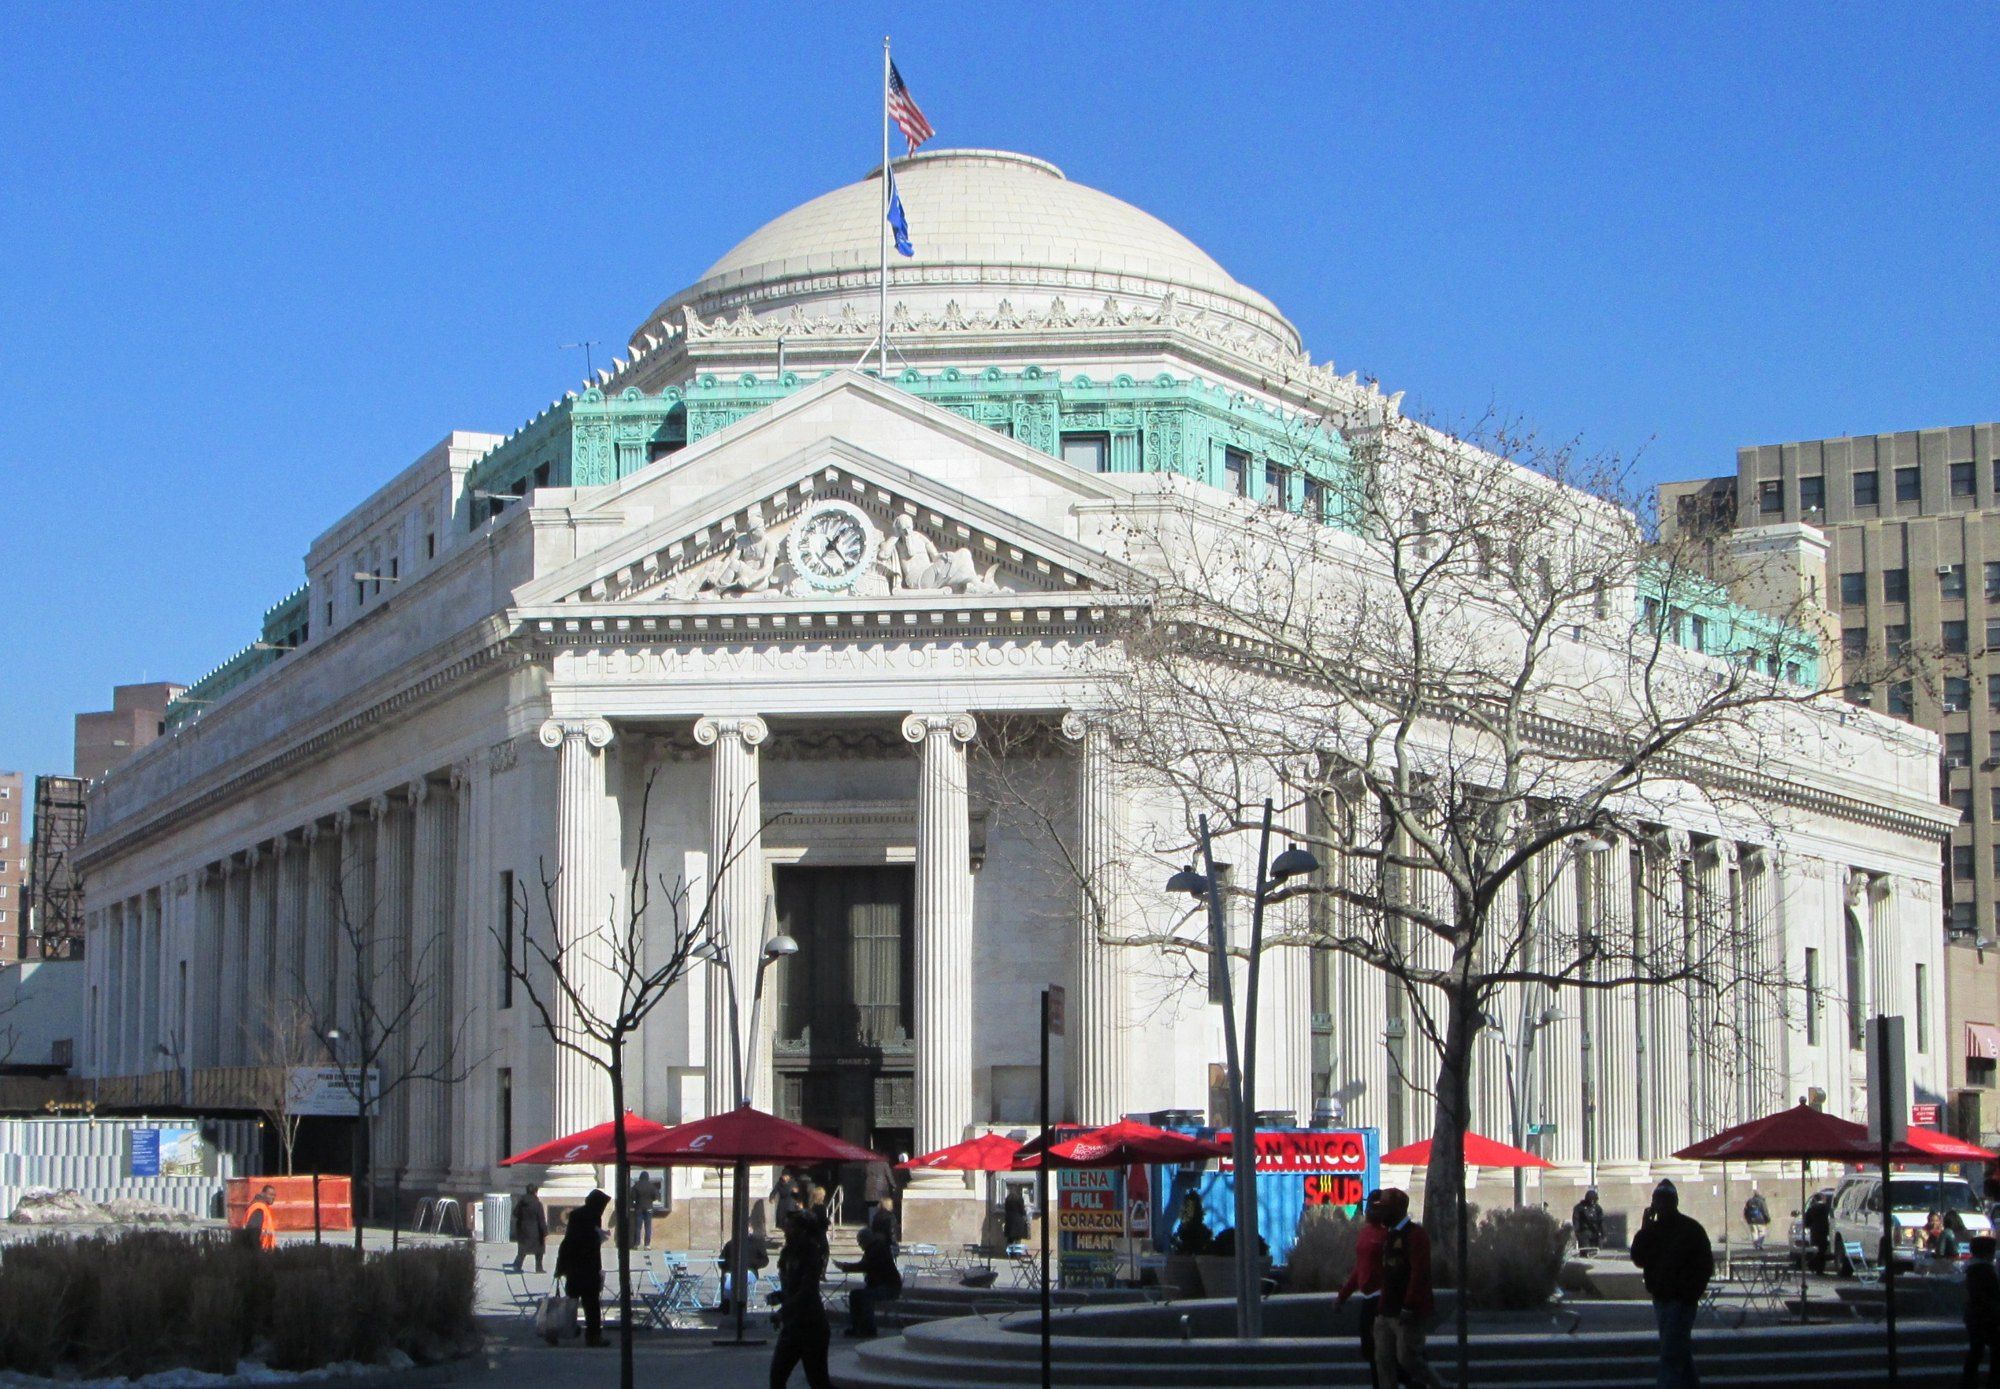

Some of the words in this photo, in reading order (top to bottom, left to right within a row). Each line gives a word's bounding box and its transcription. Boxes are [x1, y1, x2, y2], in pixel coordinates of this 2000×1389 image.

[567, 653, 618, 674] THE
[630, 652, 694, 674] DIME
[703, 649, 808, 673] SAVINGS
[825, 648, 897, 670] BANK
[907, 647, 939, 669] OF
[952, 643, 1103, 668] BROOKLYN
[1293, 1140, 1361, 1165] NICO
[1062, 1171, 1109, 1187] LLENA
[1060, 1213, 1123, 1229] CORAZON
